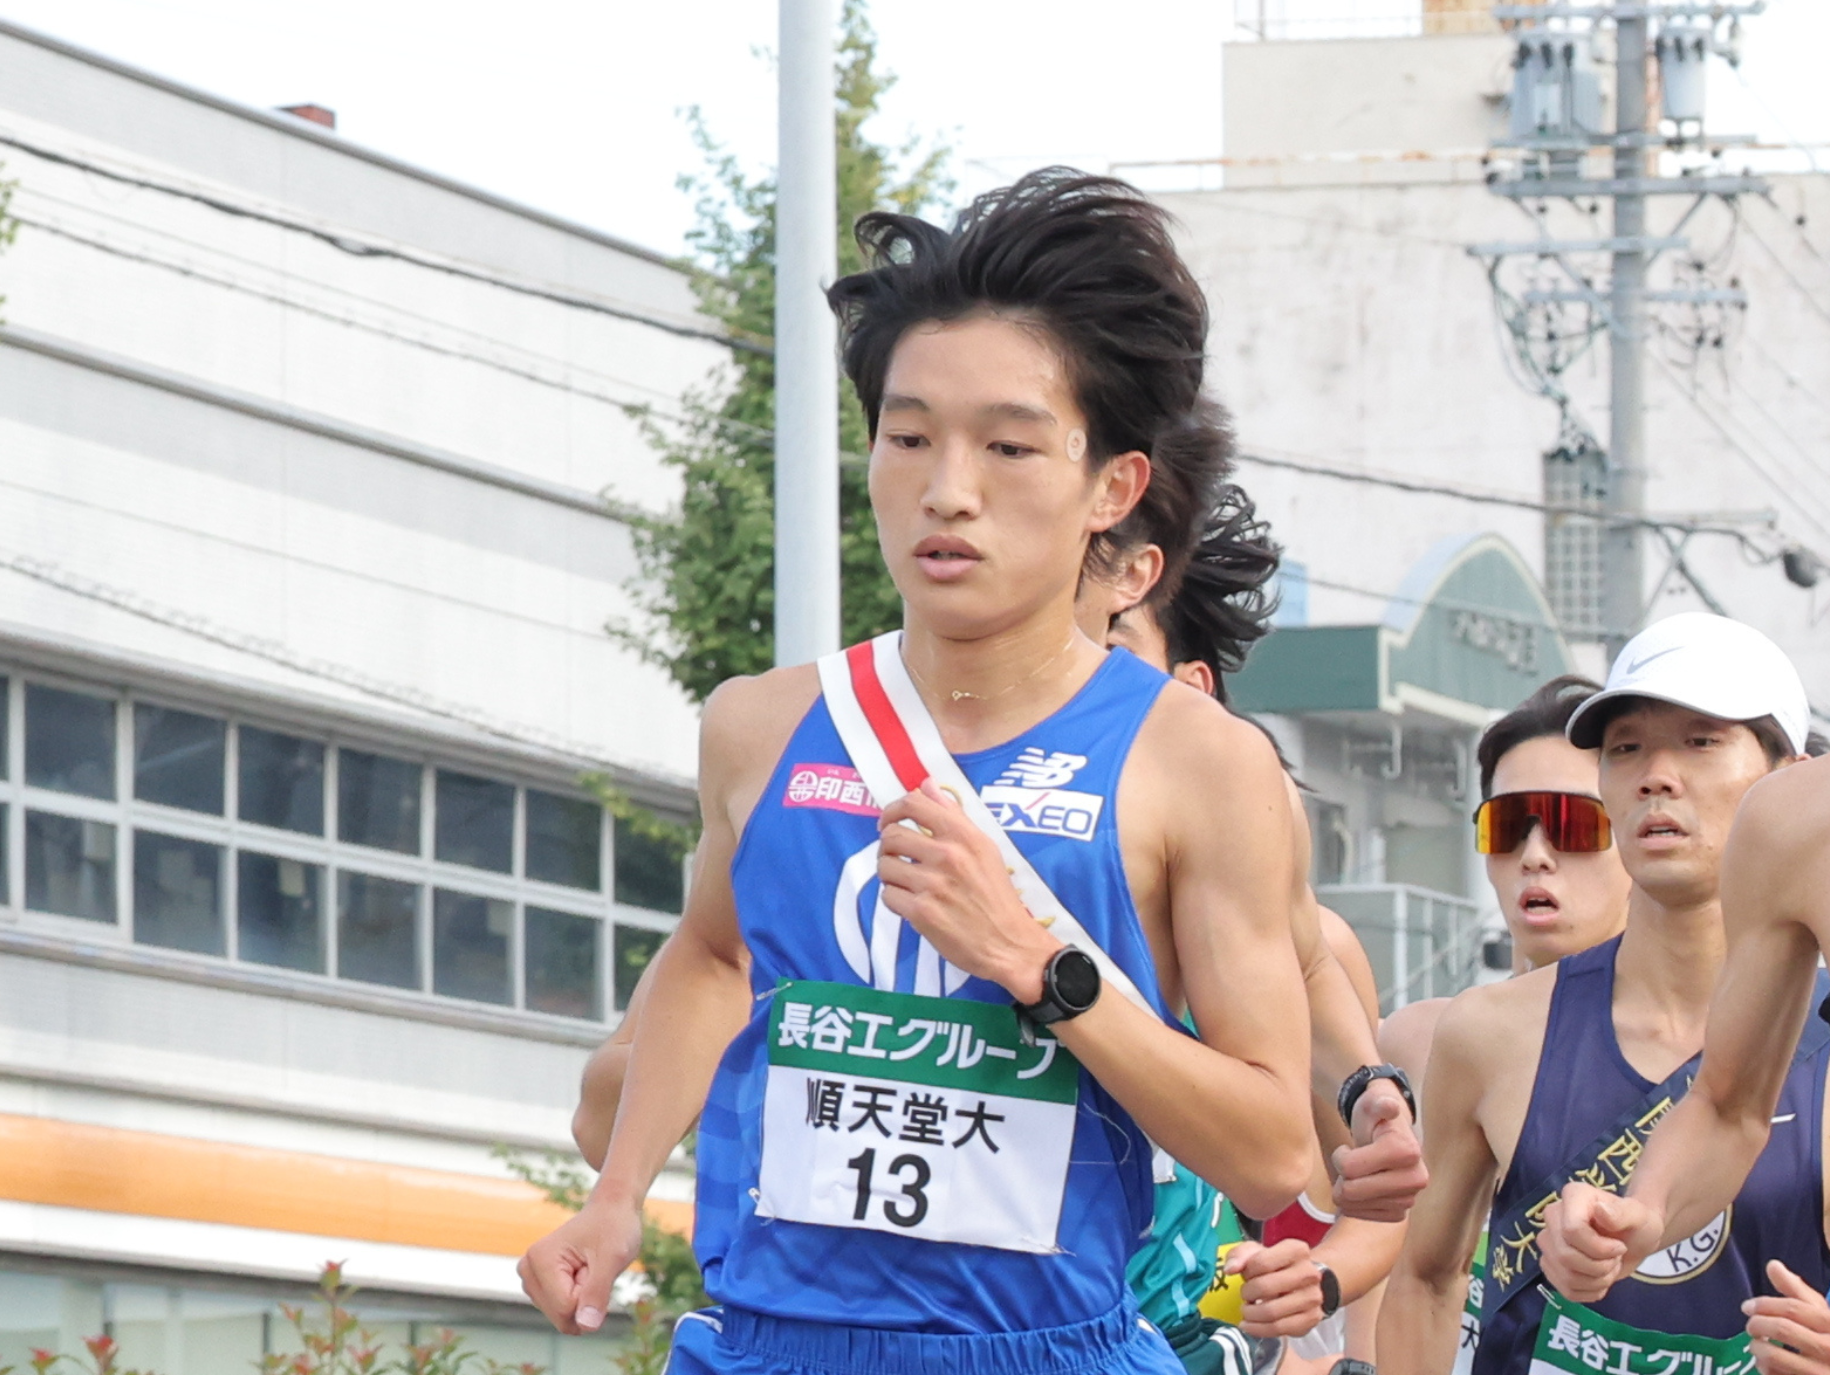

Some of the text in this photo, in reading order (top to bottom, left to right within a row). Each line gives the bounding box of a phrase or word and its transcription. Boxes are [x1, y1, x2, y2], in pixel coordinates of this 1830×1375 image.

[815, 776, 880, 809] 印西
[805, 1077, 1006, 1154] 順天堂大
[847, 1147, 932, 1228] 13
